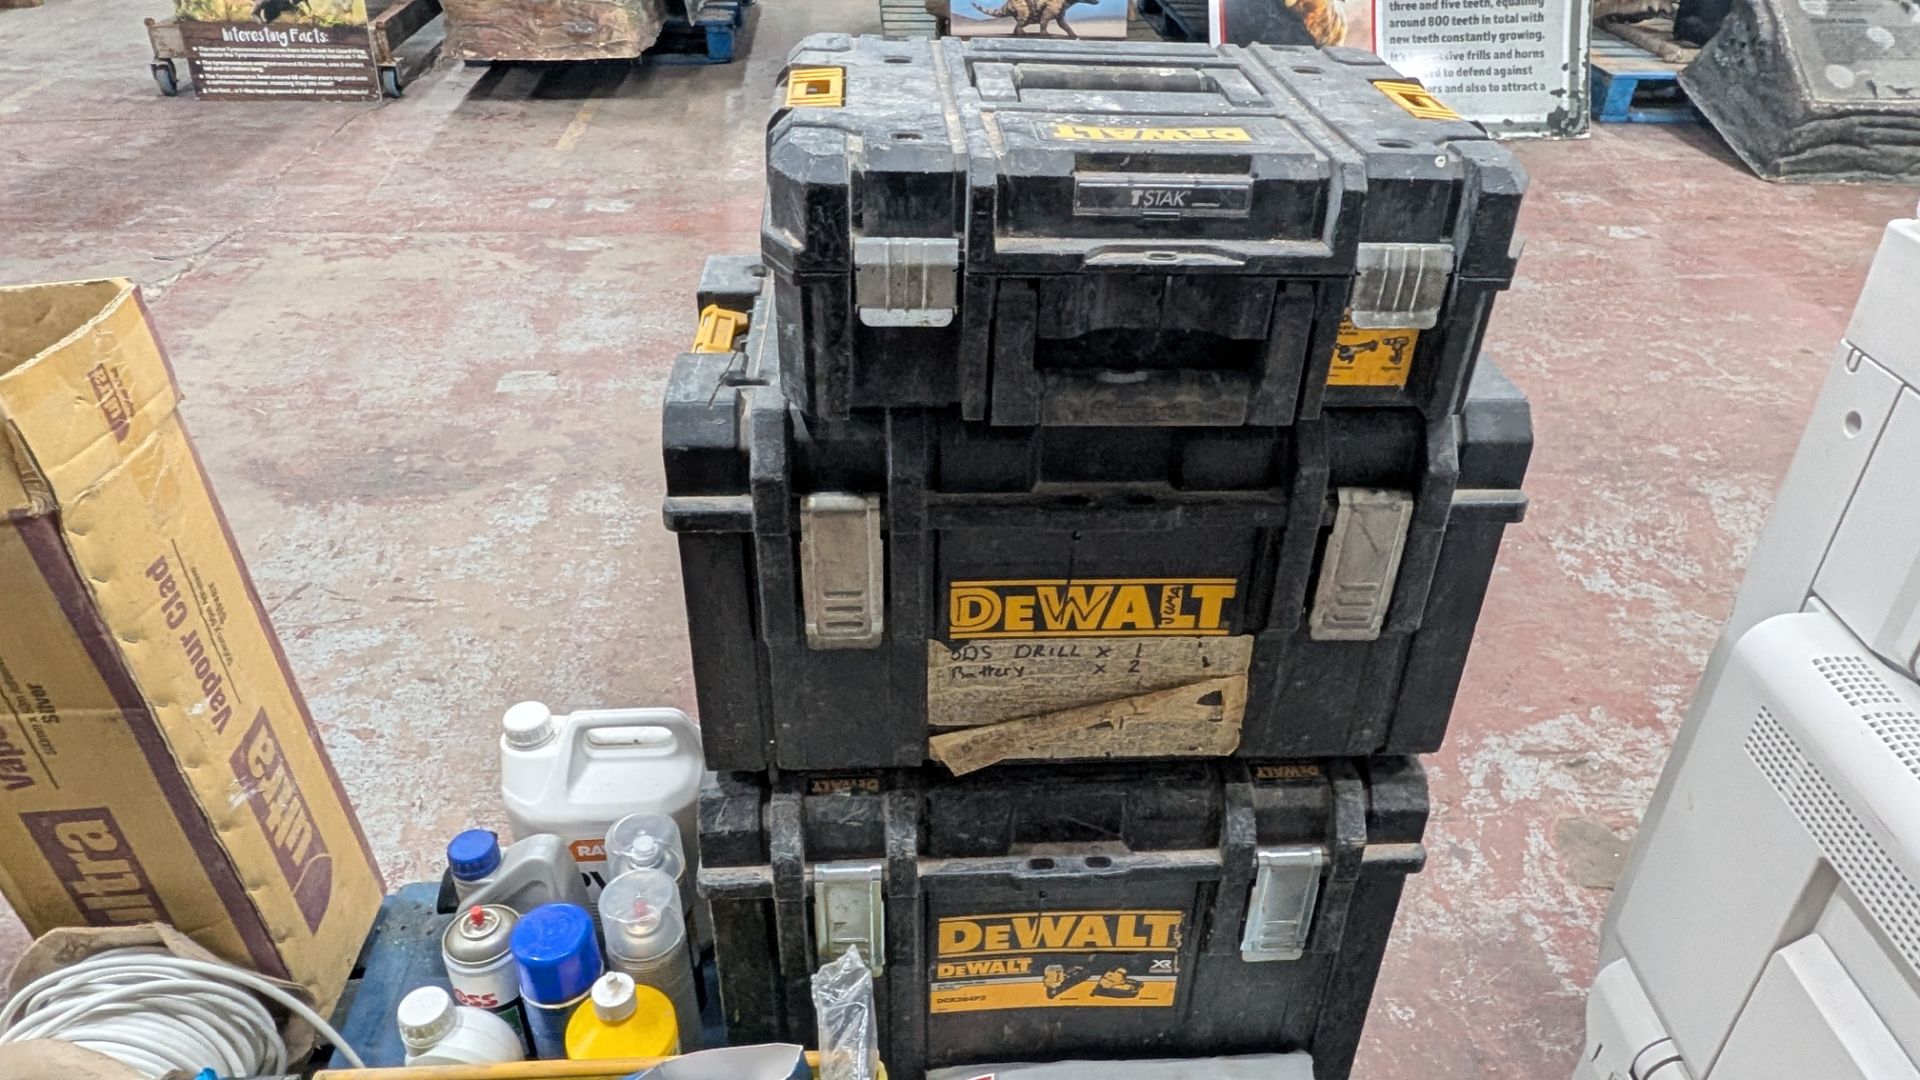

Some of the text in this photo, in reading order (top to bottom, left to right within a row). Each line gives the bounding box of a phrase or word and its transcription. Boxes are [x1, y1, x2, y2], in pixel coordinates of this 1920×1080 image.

[1389, 1, 1417, 11] three
[1419, 0, 1438, 10] and
[1441, 0, 1460, 9] five
[1463, 0, 1494, 9] teeth,
[1389, 12, 1544, 28] around 800 teeth in total with
[222, 26, 329, 47] Interesting Facts:
[1390, 30, 1545, 44] new teeth constantly growing.
[1468, 50, 1491, 60] frills
[1493, 49, 1513, 59] and
[1515, 48, 1545, 59] horns
[1443, 67, 1454, 77] to
[1456, 66, 1491, 77] defend
[1493, 65, 1533, 78] against
[1445, 83, 1464, 93] and
[1465, 82, 1487, 92] also
[1489, 82, 1500, 92] to
[1502, 81, 1537, 91] attract
[1540, 83, 1546, 91] a
[146, 555, 188, 630] Clad
[1014, 643, 1081, 659] DRILL
[1127, 659, 1141, 674] 2
[180, 630, 232, 736] Vapour
[247, 738, 313, 866] ultra
